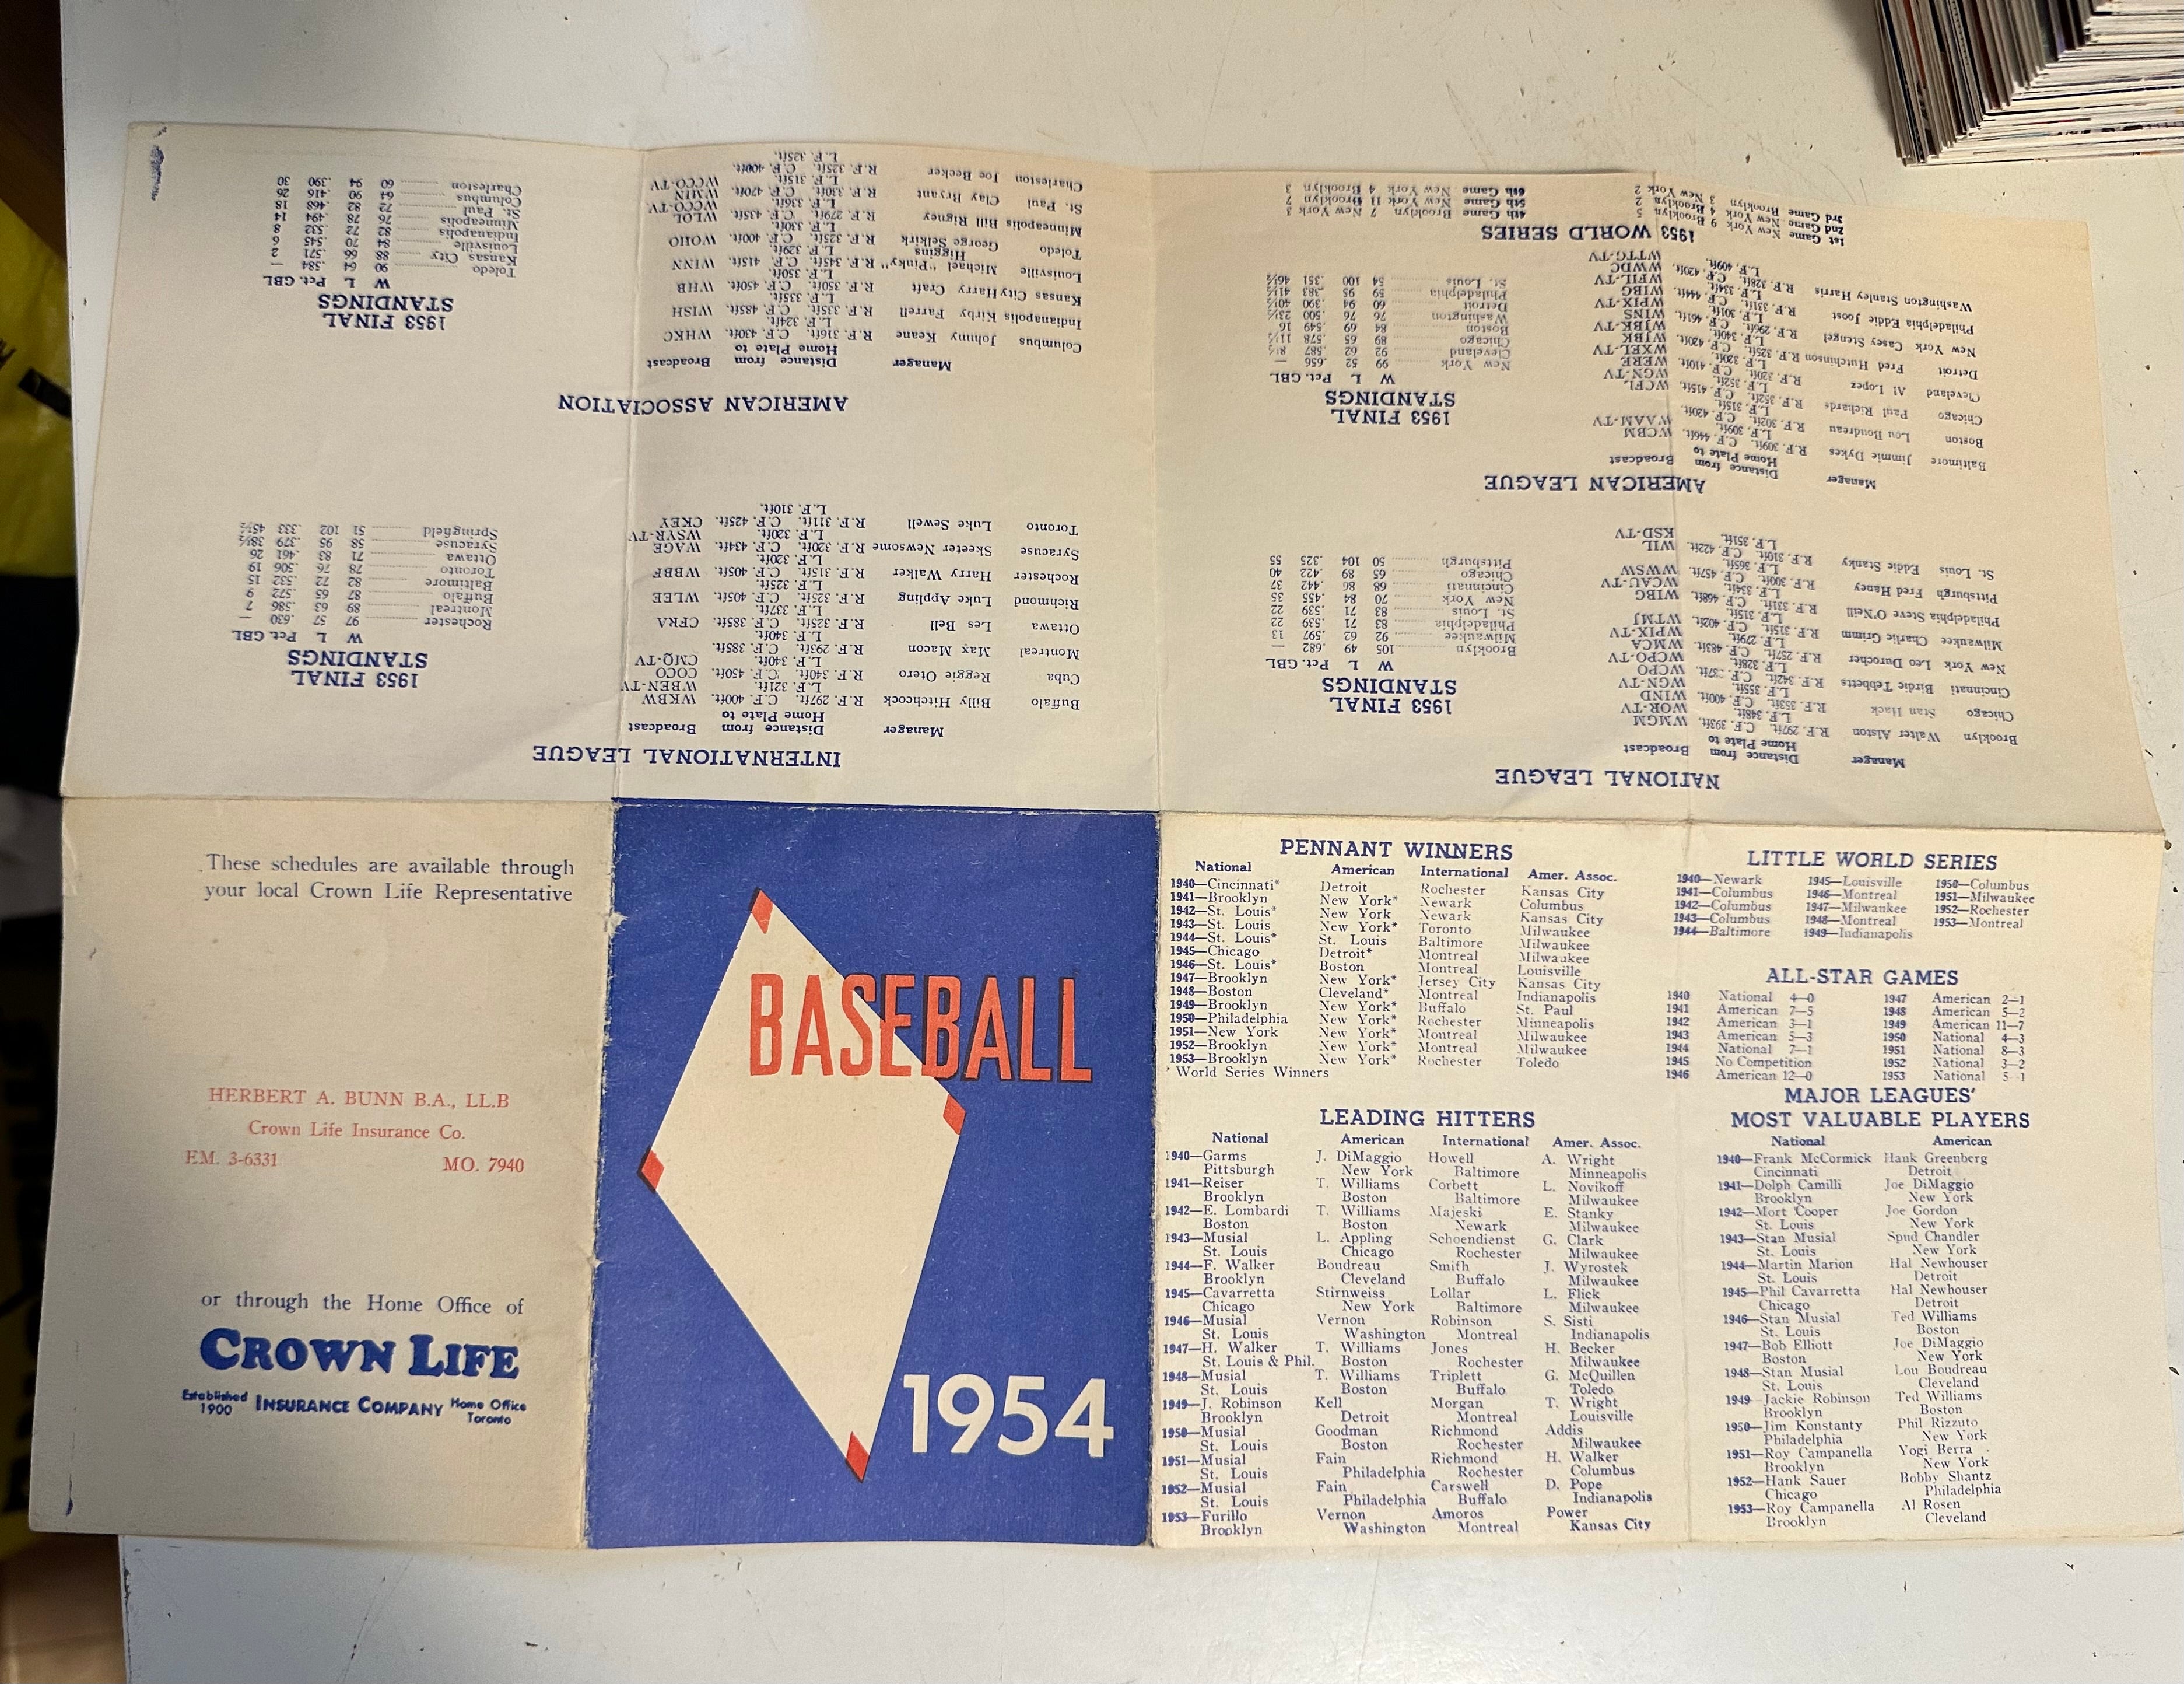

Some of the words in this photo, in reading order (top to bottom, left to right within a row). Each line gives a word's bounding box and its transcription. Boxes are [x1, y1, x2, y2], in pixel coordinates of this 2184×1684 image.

[278, 177, 290, 186] 30
[308, 177, 331, 187] .390
[350, 178, 363, 188] 94
[381, 179, 394, 189] 60
[451, 183, 522, 197] Charleston
[923, 211, 967, 227] Rigney
[976, 216, 998, 229] Bill
[1007, 219, 1082, 237] Minneapolis
[1481, 225, 1558, 240] SERIES
[1569, 224, 1652, 240] WORLD
[1656, 225, 1694, 243] 1953
[262, 275, 295, 286] GBL
[300, 276, 326, 287] Pct.
[344, 277, 356, 288] L
[374, 278, 391, 289] W
[1621, 285, 1663, 296] WIBG
[317, 293, 454, 312] STANDINGS
[1594, 297, 1664, 308] WPIX-TV
[322, 313, 395, 330] FINAL
[405, 314, 446, 330] 1953
[1832, 312, 1860, 324] Joost
[1869, 316, 1900, 329] Eddie
[1906, 320, 1973, 335] Philadelphia
[664, 330, 711, 342] WHKC
[896, 331, 937, 343] Keane
[951, 332, 996, 346] Johnny
[1019, 337, 1081, 353] Columbus
[647, 357, 710, 369] Broadcast
[735, 356, 765, 367] from
[780, 356, 837, 368] Distance
[893, 358, 952, 371] Manager
[558, 394, 713, 415] ASSOCIATION
[724, 396, 849, 412] AMERICAN
[1325, 390, 1455, 407] STANDINGS
[1331, 409, 1400, 425] FINAL
[1411, 410, 1449, 425] 1953
[1829, 449, 1864, 461] Dykes
[1871, 453, 1912, 465] Jimmie
[1484, 475, 1577, 491] LEAGUE
[1589, 474, 1705, 494] AMERICAN
[653, 542, 701, 554] WAGE
[872, 543, 935, 555] Newsome
[943, 545, 991, 556] Skeeter
[1021, 547, 1079, 561] Syracuse
[270, 614, 294, 625] .630
[345, 616, 359, 626] 97
[1272, 630, 1283, 639] 13
[1303, 630, 1325, 640] .597
[1344, 631, 1357, 641] 62
[1376, 632, 1389, 642] 92
[287, 650, 428, 668] STANDINGS
[290, 670, 365, 687] FINAL
[376, 672, 418, 688] 1953
[1322, 677, 1456, 695] STANDINGS
[641, 694, 696, 705] WKBW
[884, 696, 951, 708] Hitchcock
[960, 696, 991, 708] Billy
[1329, 697, 1401, 714] FINAL
[1411, 699, 1452, 715] 1953
[1621, 703, 1687, 713] WOR-TV
[1633, 715, 1687, 726] WMGM
[629, 723, 696, 734] Broadcast
[884, 724, 944, 737] Manager
[1852, 729, 1891, 740] Alston
[1898, 730, 1941, 742] Walter
[1964, 732, 2018, 745] Brooklyn
[532, 745, 631, 763] LEAGUE
[643, 749, 841, 768] INTERNATIONAL
[1495, 769, 1593, 786] LEAGUE
[1604, 771, 1720, 790] NATIONAL
[1280, 839, 1392, 857] PENNANT
[1404, 842, 1512, 860] WINNERS
[206, 854, 260, 870] These
[271, 855, 357, 872] schedules
[369, 862, 398, 873] are
[409, 857, 490, 874] available
[501, 859, 573, 880] through
[1195, 860, 1251, 872] National
[1747, 850, 1825, 866] LITTLE
[1836, 852, 1914, 868] WORLD
[1924, 854, 1997, 870] SERIES
[1331, 864, 1394, 875] American
[1421, 865, 1508, 878] International
[205, 886, 247, 897] your
[258, 881, 298, 897] local
[310, 882, 372, 898] Crown
[385, 883, 422, 899] Life
[435, 884, 572, 905] Representative
[1320, 881, 1367, 892] Detroit
[1522, 885, 1568, 897] Kansas
[1577, 887, 1604, 900] City
[1765, 968, 1873, 984] ALL-STAR
[1884, 969, 1958, 985] GAMES
[1668, 990, 1690, 1000] 1940
[1719, 990, 1772, 1002] National
[749, 972, 1093, 1082] BASEBALL
[1715, 1056, 1733, 1066] No
[1737, 1056, 1812, 1069] Competition
[1176, 1066, 1217, 1077] World
[1226, 1066, 1264, 1077] Series
[1273, 1066, 1328, 1077] Winners
[210, 1088, 306, 1104] HERBERT
[317, 1091, 334, 1104] A.
[345, 1091, 404, 1106] BUNN
[467, 1093, 509, 1108] LL.B
[1785, 1087, 1860, 1103] MAJOR
[1320, 1109, 1425, 1126] LEADING
[1436, 1111, 1535, 1128] HITTERS
[1731, 1112, 1792, 1128] MOST
[1802, 1111, 1921, 1127] VALUABLE
[1931, 1112, 2029, 1128] PLAYERS
[249, 1120, 300, 1135] Crown
[311, 1122, 342, 1136] Life
[352, 1123, 429, 1139] Insurance
[439, 1125, 465, 1139] Co.
[186, 1150, 219, 1164] EM.
[229, 1153, 276, 1166] 3-6331
[443, 1157, 479, 1172] MO.
[489, 1157, 524, 1172] 7940
[1337, 1150, 1401, 1164] DiMaggio
[1429, 1152, 1473, 1164] Howell
[1566, 1154, 1614, 1167] Wright
[1801, 1153, 1871, 1163] McCormick
[1924, 1152, 1987, 1165] Greenberg
[1204, 1163, 1274, 1177] Pittsburgh
[1316, 1286, 1384, 1298] Stirnweiss
[201, 1296, 221, 1306] or
[236, 1291, 308, 1313] through
[323, 1294, 351, 1310] the
[367, 1294, 423, 1312] Home
[437, 1296, 491, 1314] Office
[507, 1298, 524, 1314] of
[200, 1327, 396, 1373] CROWN
[408, 1334, 519, 1379] LIFE
[181, 1389, 248, 1402] Established
[201, 1403, 232, 1416] 1900
[256, 1394, 350, 1413] INSURANCE
[357, 1396, 444, 1416] COMPANY
[451, 1397, 484, 1410] Home
[490, 1398, 527, 1412] Office
[468, 1412, 511, 1425] Toronto
[903, 1373, 1114, 1458] 1954
[1315, 1424, 1378, 1436] Goodman
[1795, 1420, 1862, 1432] Konstanty
[1931, 1417, 1978, 1427] Rizzuto
[1201, 1524, 1262, 1537] Brooklyn
[1344, 1522, 1426, 1535] Washington
[1457, 1521, 1518, 1533] Montreal
